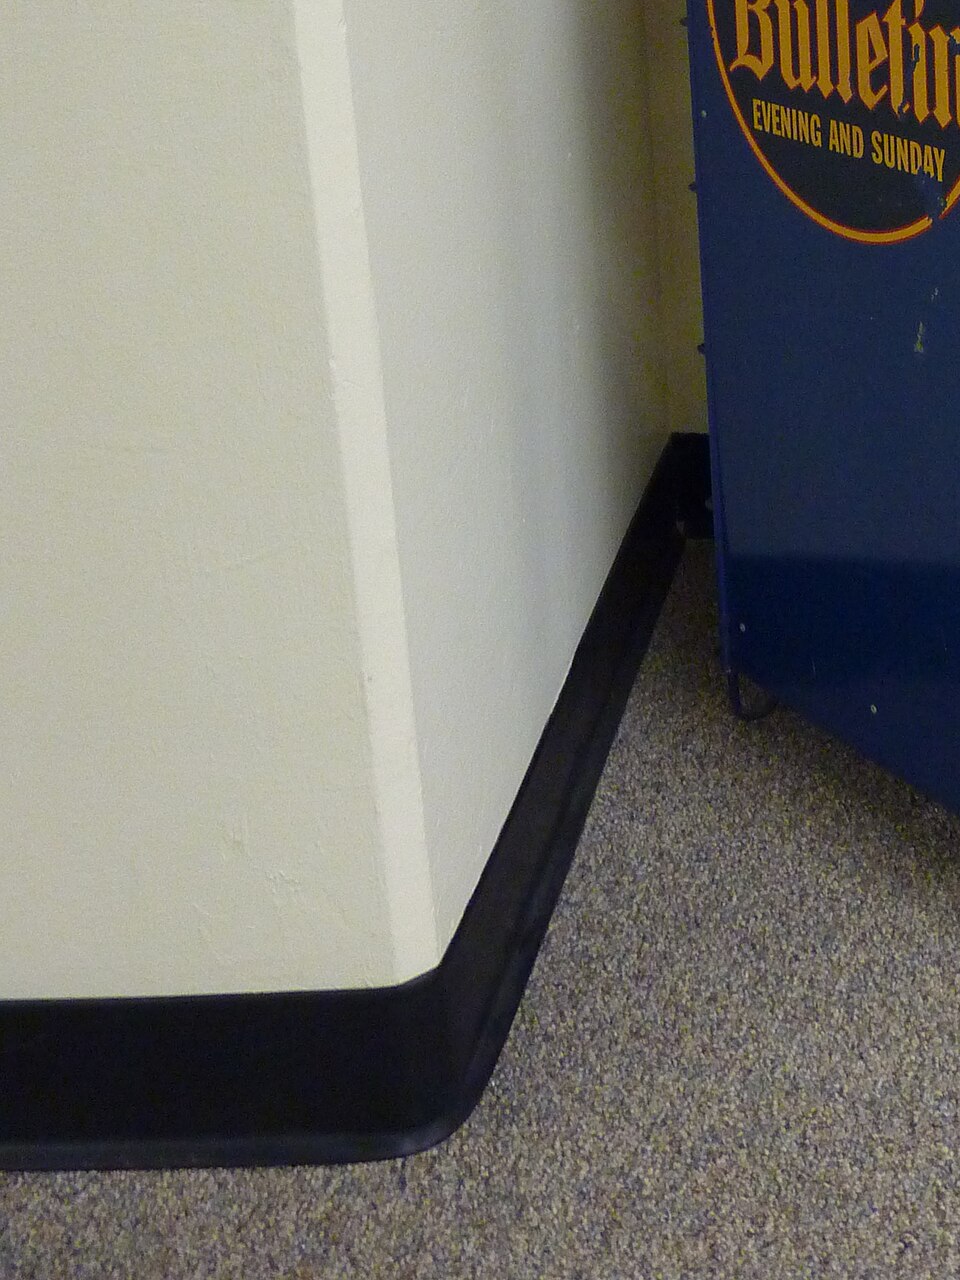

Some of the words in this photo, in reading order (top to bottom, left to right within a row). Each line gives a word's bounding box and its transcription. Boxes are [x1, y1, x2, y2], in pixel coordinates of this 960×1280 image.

[752, 98, 822, 149] EVENING
[828, 123, 865, 160] AND
[871, 130, 946, 183] SUNDAY
